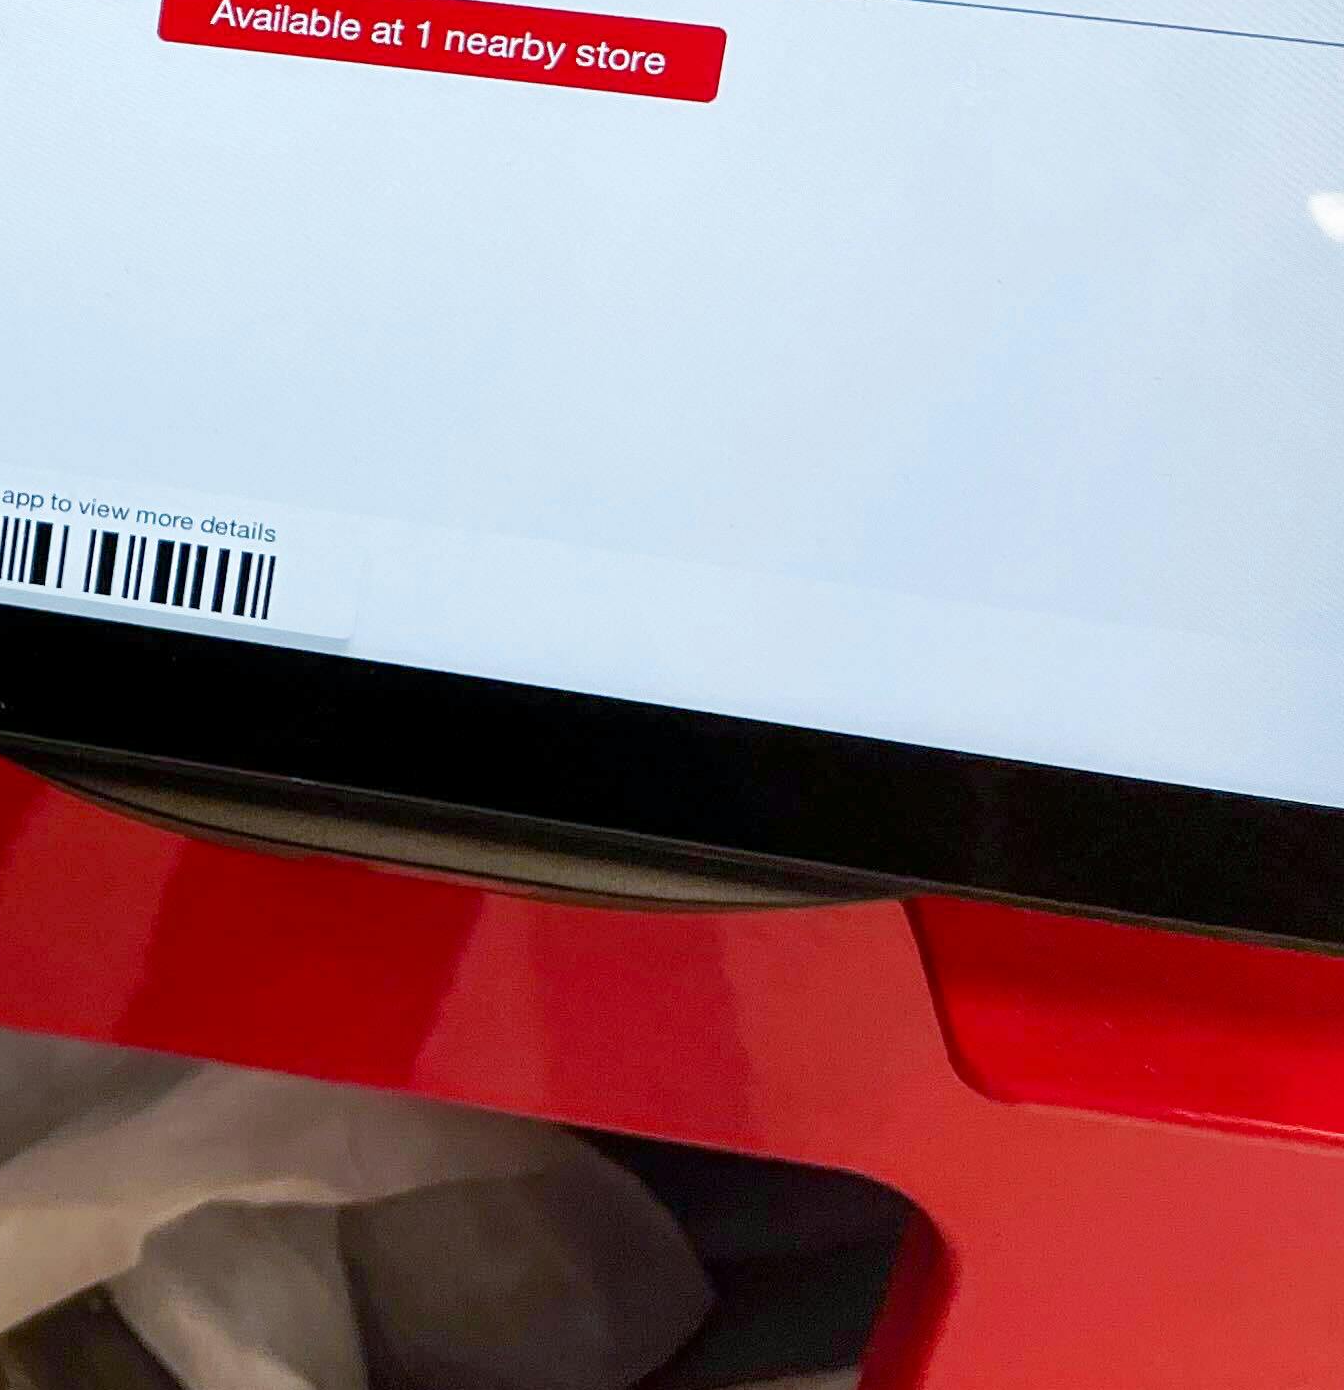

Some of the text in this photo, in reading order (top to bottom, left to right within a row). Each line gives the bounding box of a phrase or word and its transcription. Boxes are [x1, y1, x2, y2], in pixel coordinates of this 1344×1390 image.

[370, 18, 405, 45] at
[416, 21, 430, 48] 1
[444, 29, 567, 71] nearby
[575, 43, 666, 74] store
[2, 488, 45, 513] app
[51, 492, 72, 513] to
[79, 497, 130, 524] view
[136, 507, 194, 531] more
[200, 514, 277, 543] details
